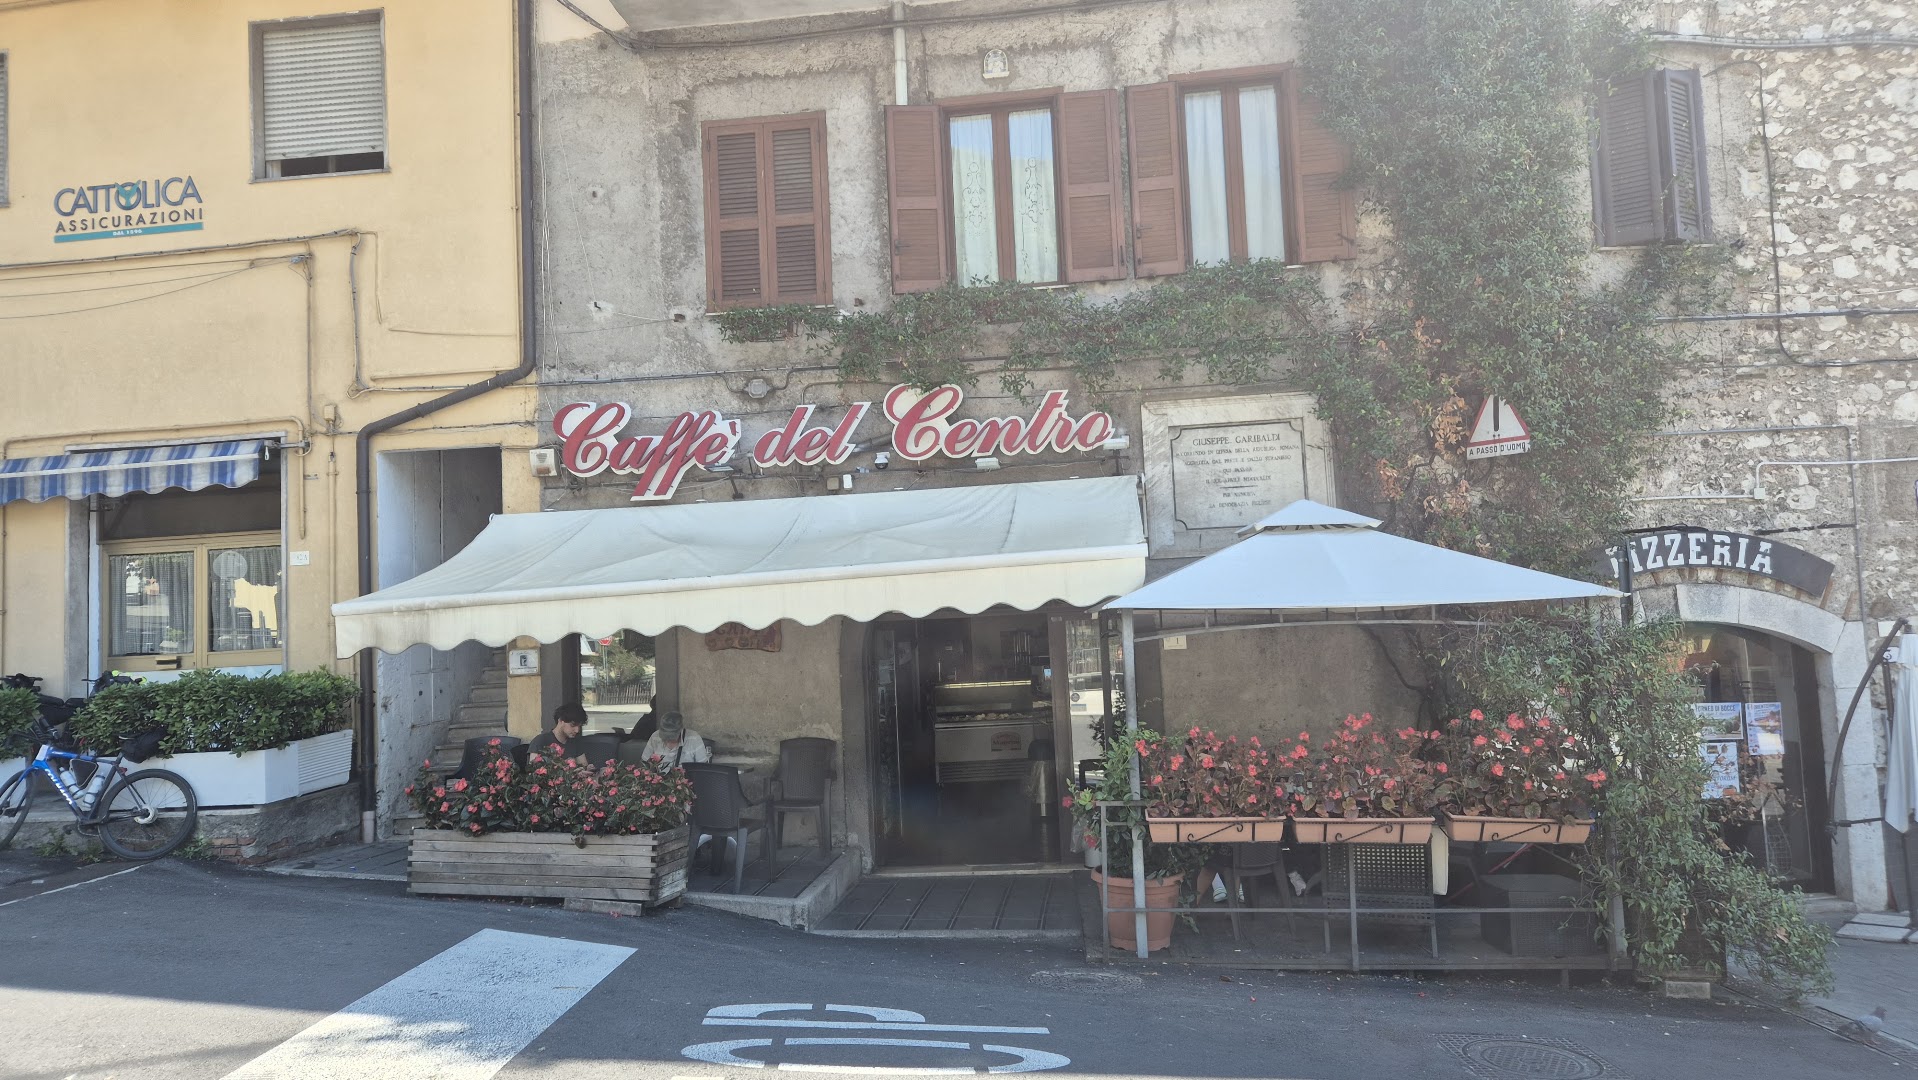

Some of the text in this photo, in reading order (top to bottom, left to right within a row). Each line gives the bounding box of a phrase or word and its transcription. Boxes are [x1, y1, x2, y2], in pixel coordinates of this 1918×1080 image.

[54, 175, 203, 217] CATTOLICA
[55, 208, 203, 233] ASSICURAZIONI
[754, 402, 871, 466] del
[884, 384, 1114, 460] Centro
[1235, 433, 1281, 444] GARIBALDI
[1476, 445, 1498, 455] PASSO
[1500, 441, 1526, 452] D'UOMO
